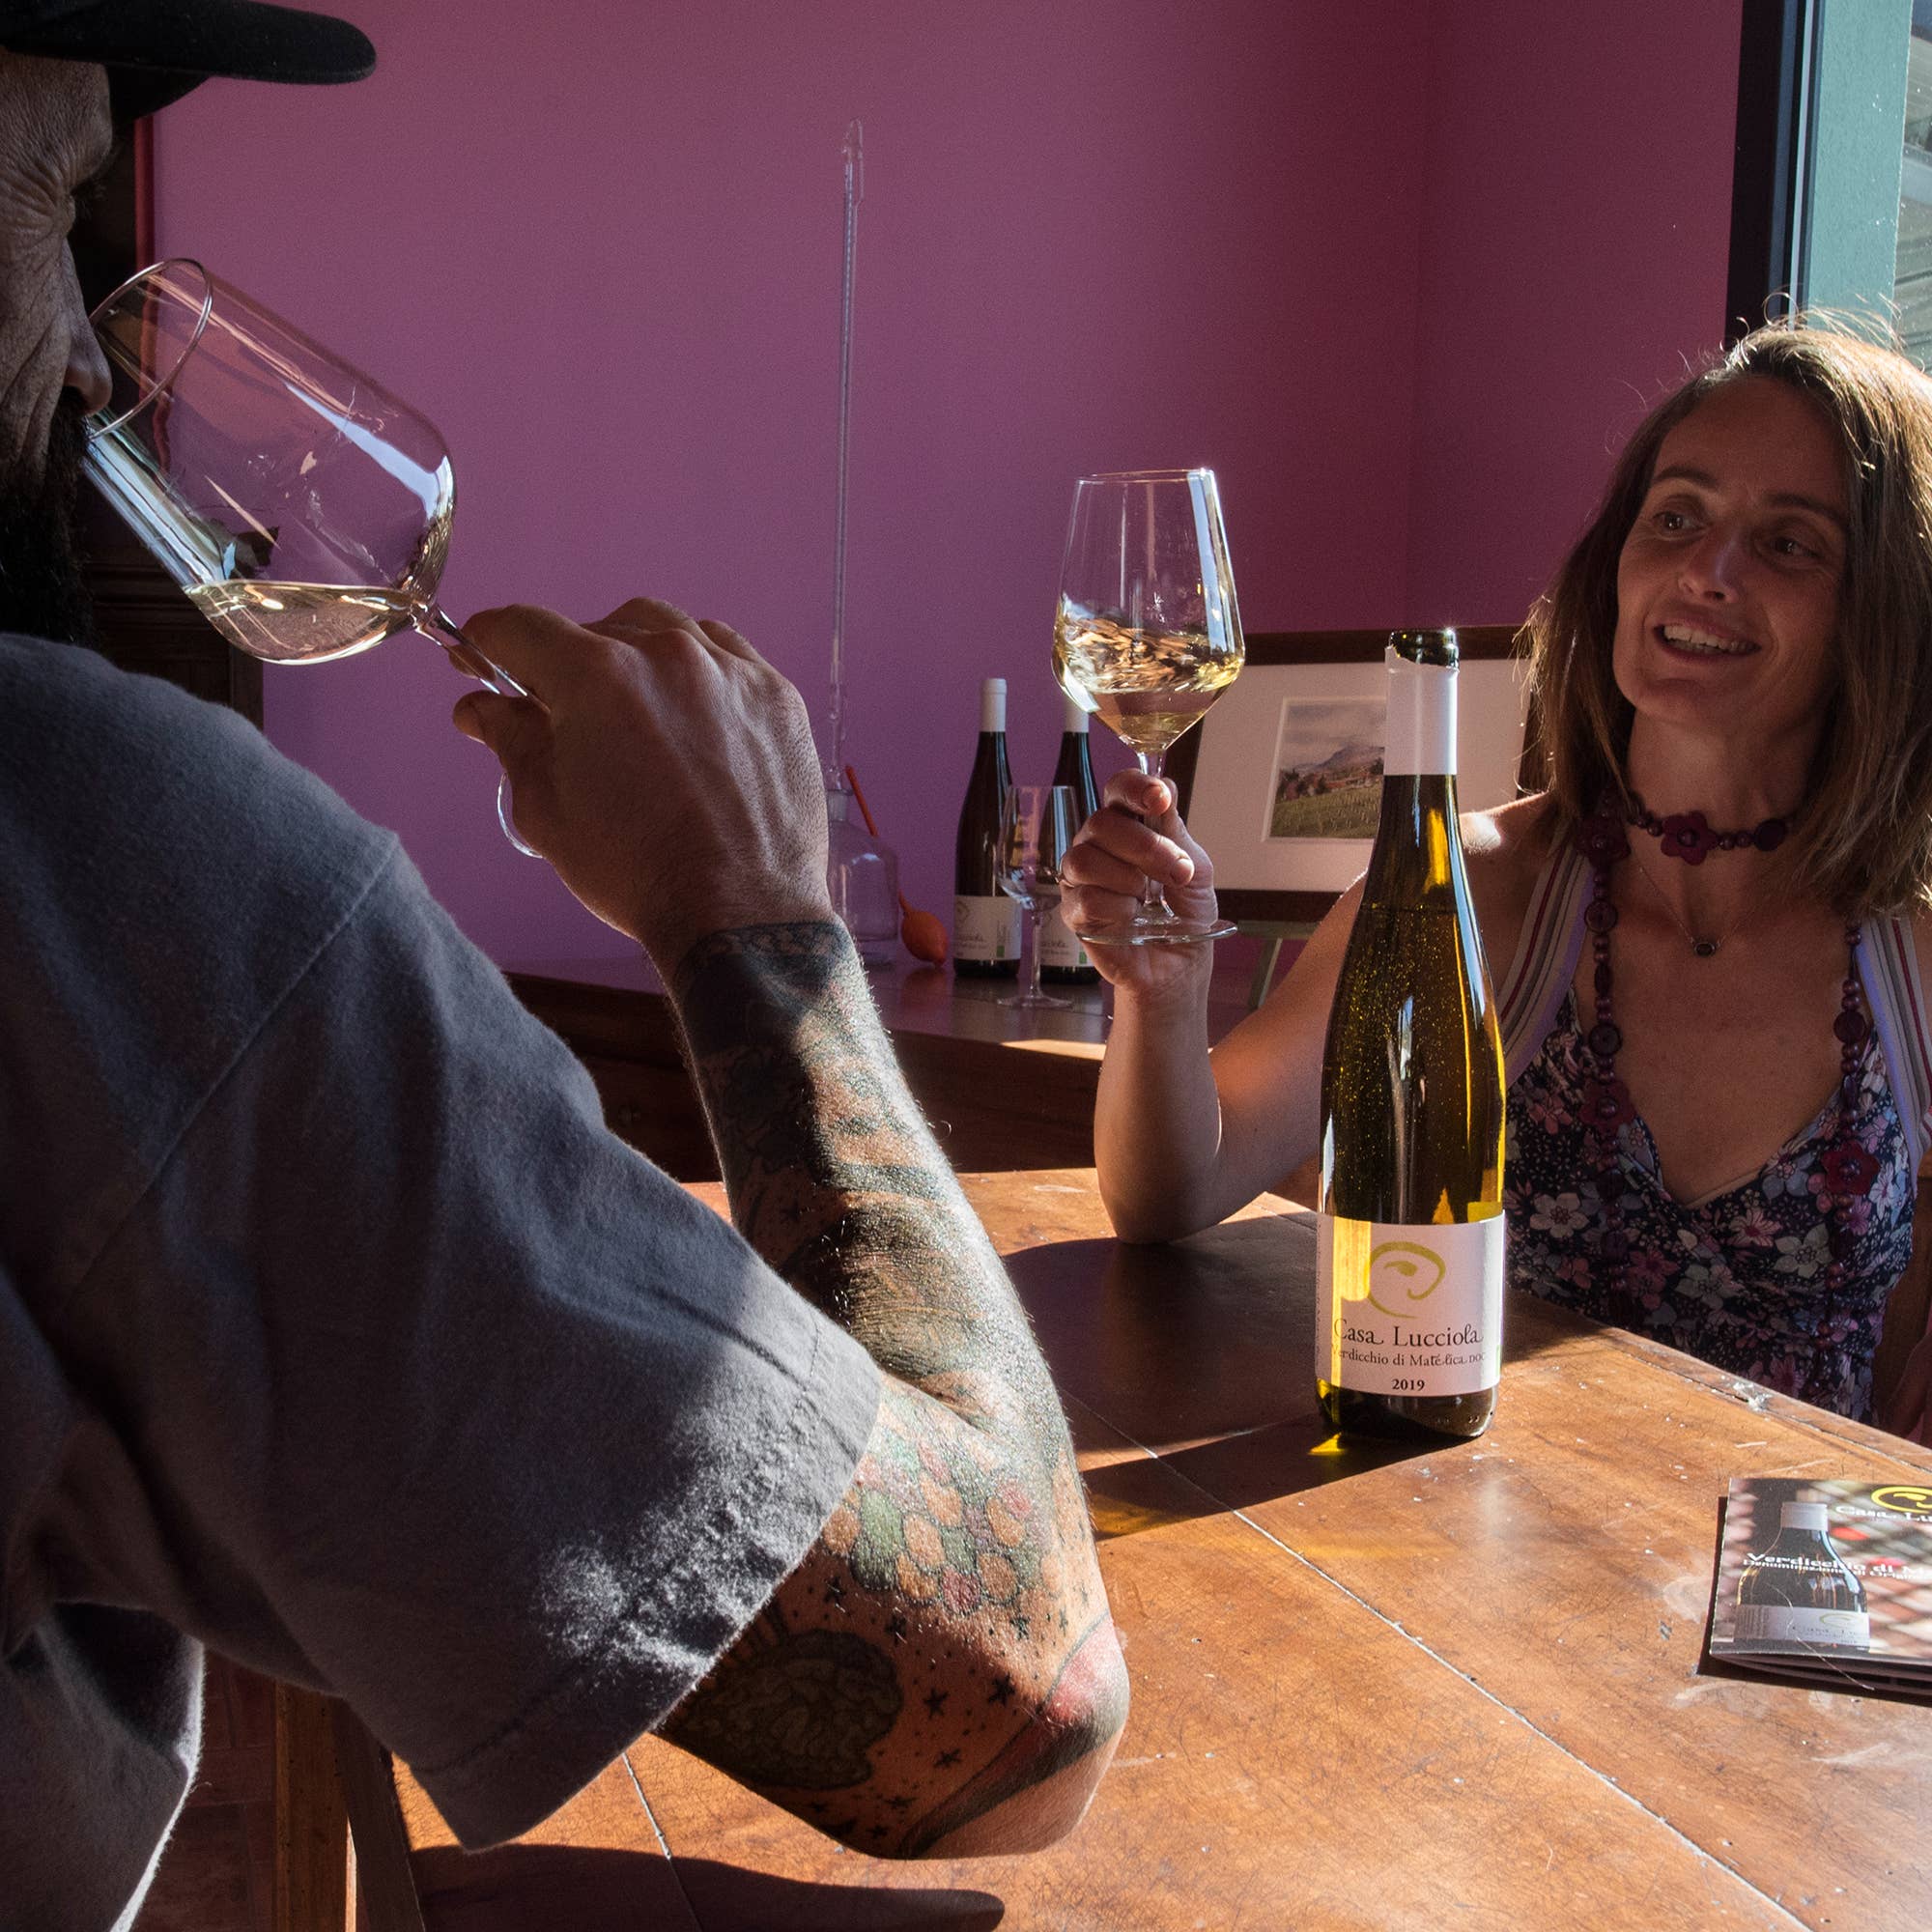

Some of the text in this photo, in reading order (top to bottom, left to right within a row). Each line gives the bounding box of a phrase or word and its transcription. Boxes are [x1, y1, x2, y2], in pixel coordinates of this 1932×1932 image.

[1333, 1318, 1484, 1348] Casa Lucciola
[1392, 1353, 1405, 1366] di
[1391, 1378, 1426, 1391] 2019
